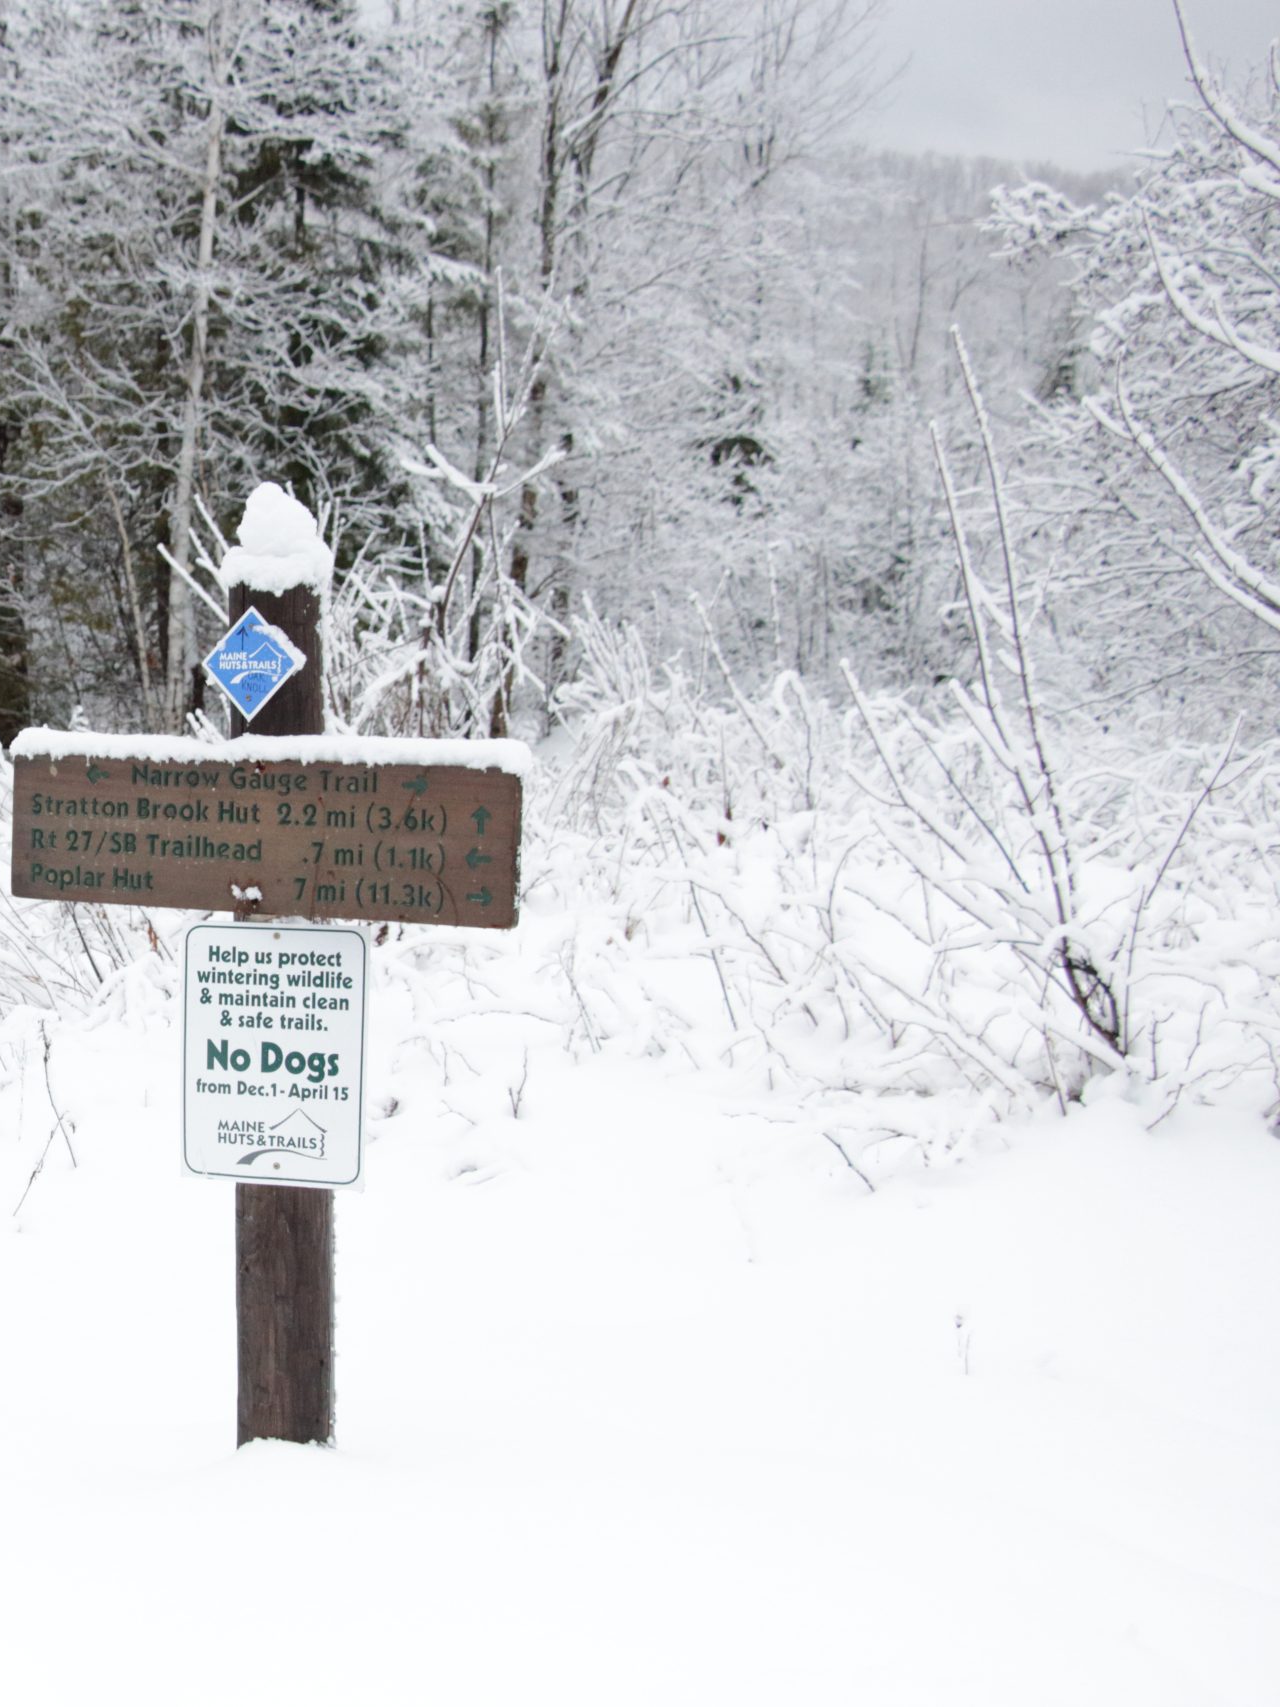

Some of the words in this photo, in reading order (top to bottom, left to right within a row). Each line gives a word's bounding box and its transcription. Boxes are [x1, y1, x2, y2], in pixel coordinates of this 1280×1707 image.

[219, 652, 247, 660] MAINE
[219, 661, 277, 670] HUTS&TRAILS
[131, 765, 220, 789] Narrow
[232, 766, 307, 797] Gauge
[320, 771, 379, 794] Trail
[31, 793, 130, 819] Stratton
[138, 799, 209, 822] Brook
[217, 802, 260, 824] Hut
[277, 803, 317, 826] 2.2
[327, 805, 357, 828] mi
[365, 804, 448, 835] (3.6k)
[31, 830, 57, 851] Rt
[65, 831, 138, 857] 27/SB
[146, 834, 262, 862] Trailhead
[301, 842, 324, 864] .7
[334, 843, 364, 867] mi
[374, 841, 446, 873] (1.1k)
[30, 864, 105, 891] Poplar
[112, 868, 154, 890] Hut
[294, 878, 307, 901] 7
[317, 880, 347, 903] mi
[355, 878, 446, 911] (11.3k)
[209, 946, 249, 966] Help
[255, 952, 272, 964] us
[279, 951, 342, 968] protect
[197, 968, 280, 989] wintering
[287, 971, 353, 989] wildlife
[200, 988, 212, 1005] &
[219, 991, 296, 1008] maintain
[303, 993, 349, 1010] clean
[220, 1010, 232, 1027] &
[238, 1012, 273, 1029] safe
[280, 1014, 328, 1031] trails.
[206, 1039, 251, 1072] No
[261, 1041, 340, 1083] Dogs
[196, 1079, 231, 1094] from
[334, 1087, 349, 1101] 15
[218, 1120, 265, 1132] MAINE
[218, 1134, 317, 1149] HUTS&TRAILS
